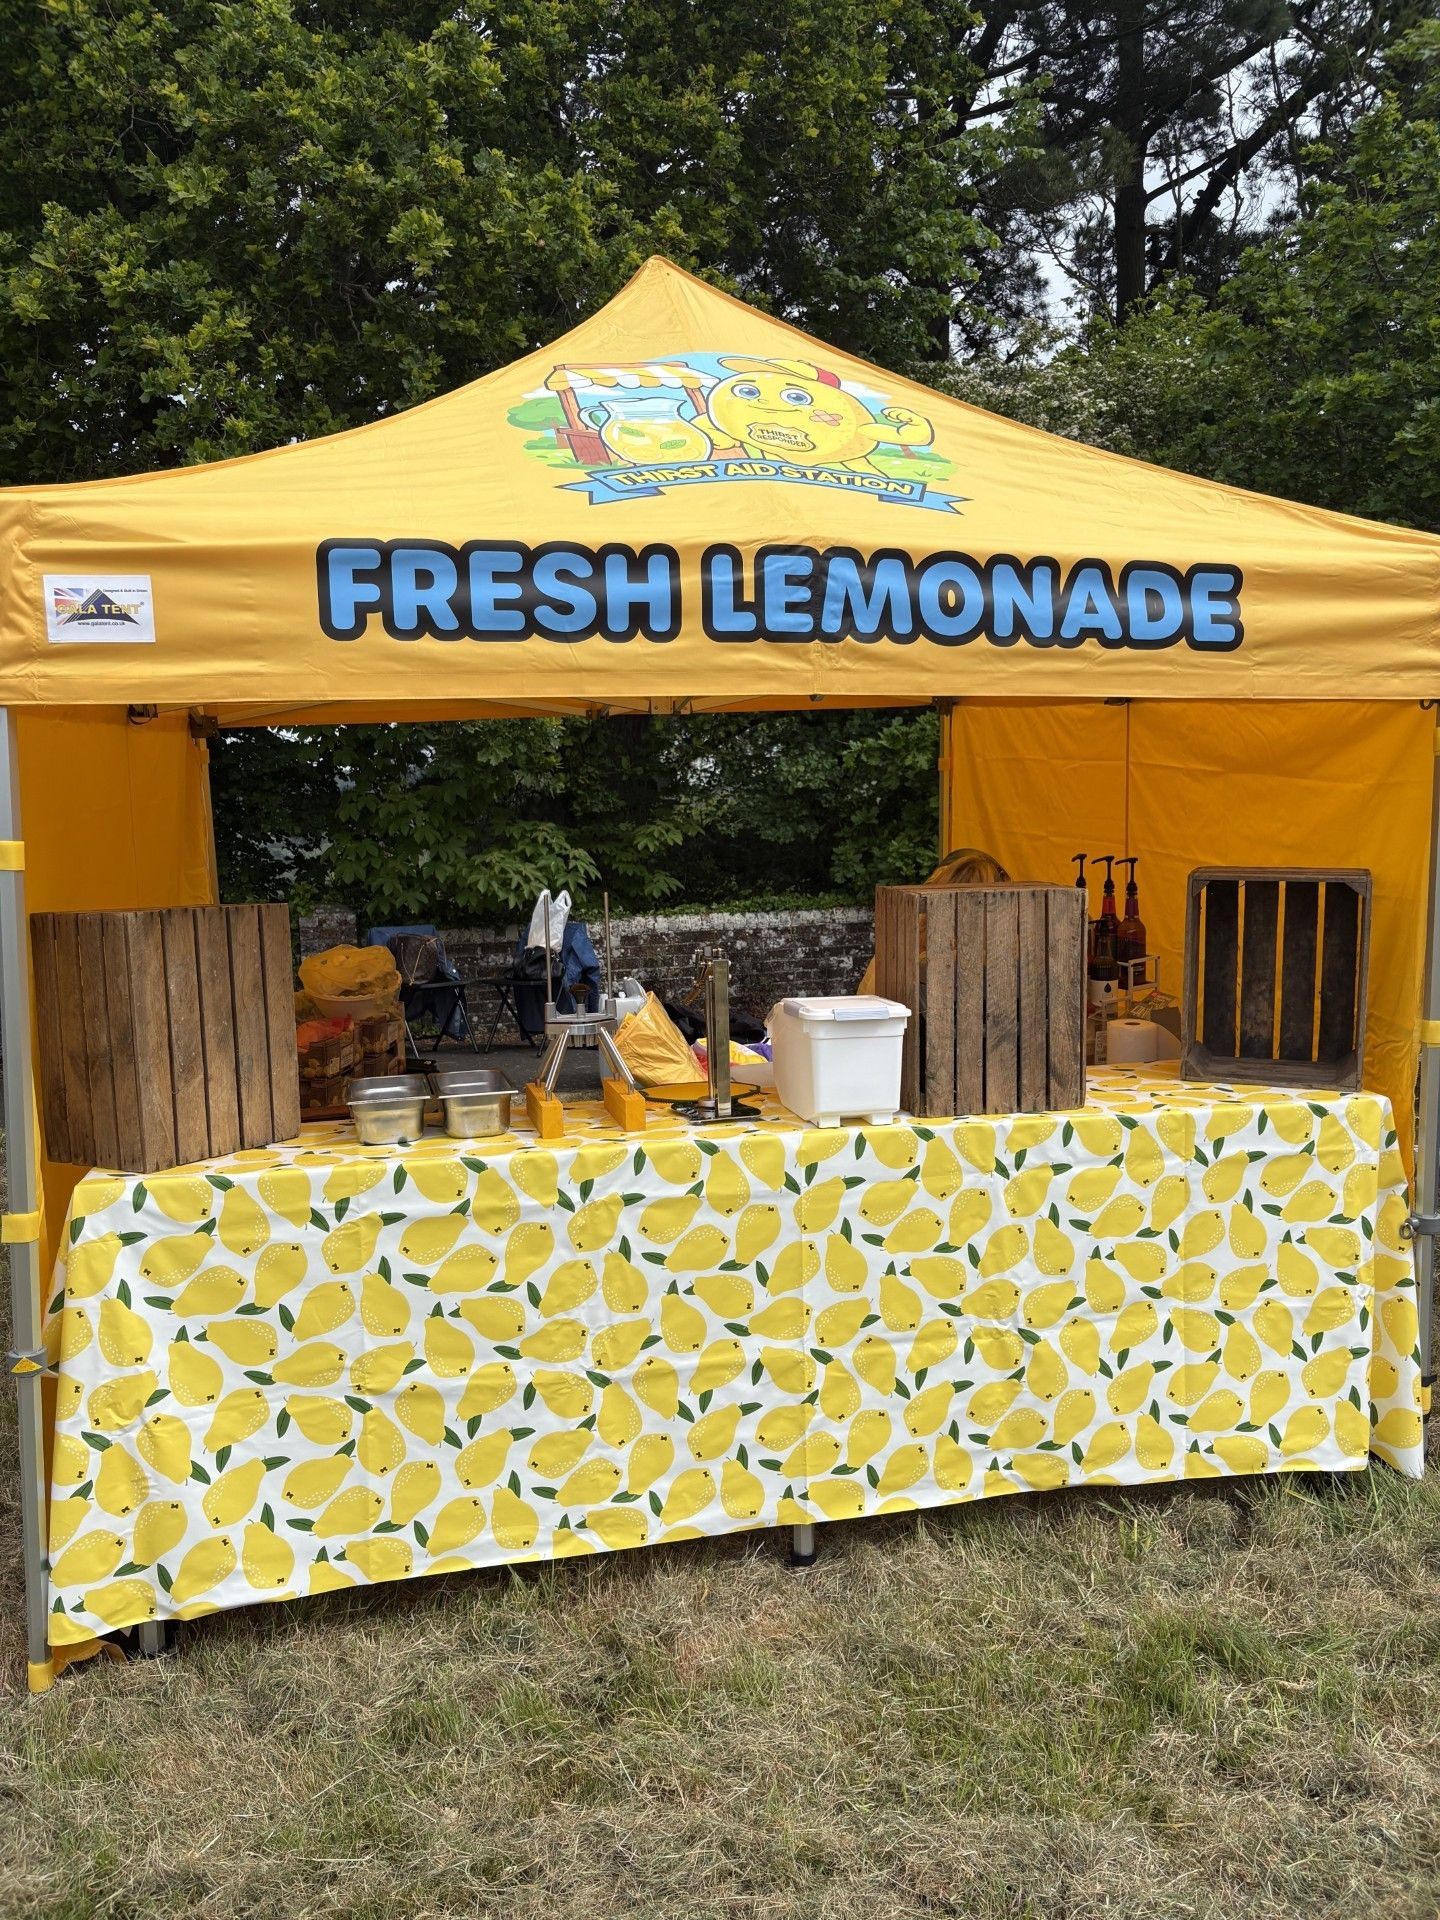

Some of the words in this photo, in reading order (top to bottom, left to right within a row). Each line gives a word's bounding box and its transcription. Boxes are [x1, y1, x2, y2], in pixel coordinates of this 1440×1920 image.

[756, 434, 808, 448] RESPONDER
[757, 428, 799, 441] THIRST
[603, 463, 719, 486] THIRST
[724, 462, 779, 477] AID
[779, 465, 914, 495] STATION
[316, 538, 681, 643] FRESH
[701, 543, 1244, 652] LEMONADE
[57, 604, 97, 614] GALA
[101, 604, 141, 614] TENT
